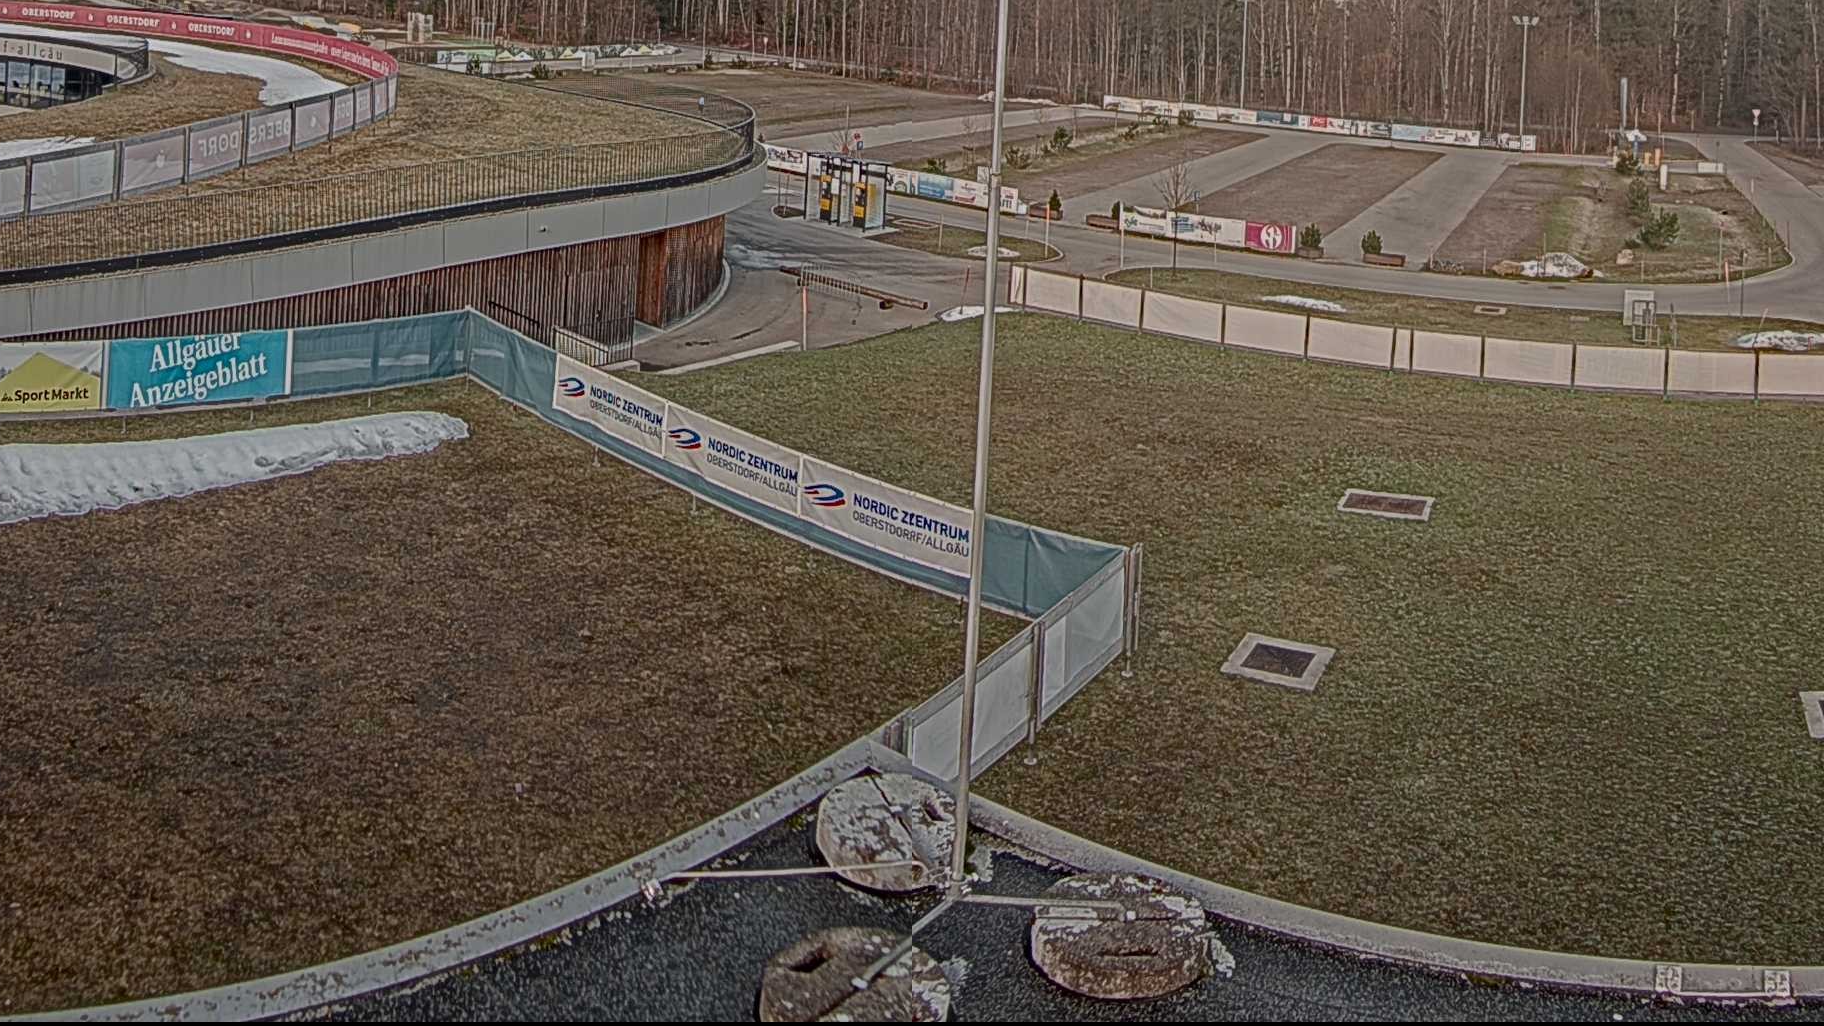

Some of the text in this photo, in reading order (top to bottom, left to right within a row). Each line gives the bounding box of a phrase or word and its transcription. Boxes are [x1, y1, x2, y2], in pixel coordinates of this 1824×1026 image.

[22, 8, 75, 19] OBERSTDORF
[106, 14, 160, 28] OBERSTDORF
[188, 22, 236, 36] OBERSTDORF
[149, 333, 241, 372] Allgäuer
[129, 352, 267, 408] Anzeigeblatt
[590, 385, 664, 427] NORDIC ZENTRUM
[708, 437, 799, 484] NORDIC ZENTRUM
[853, 493, 899, 521] NORDIC
